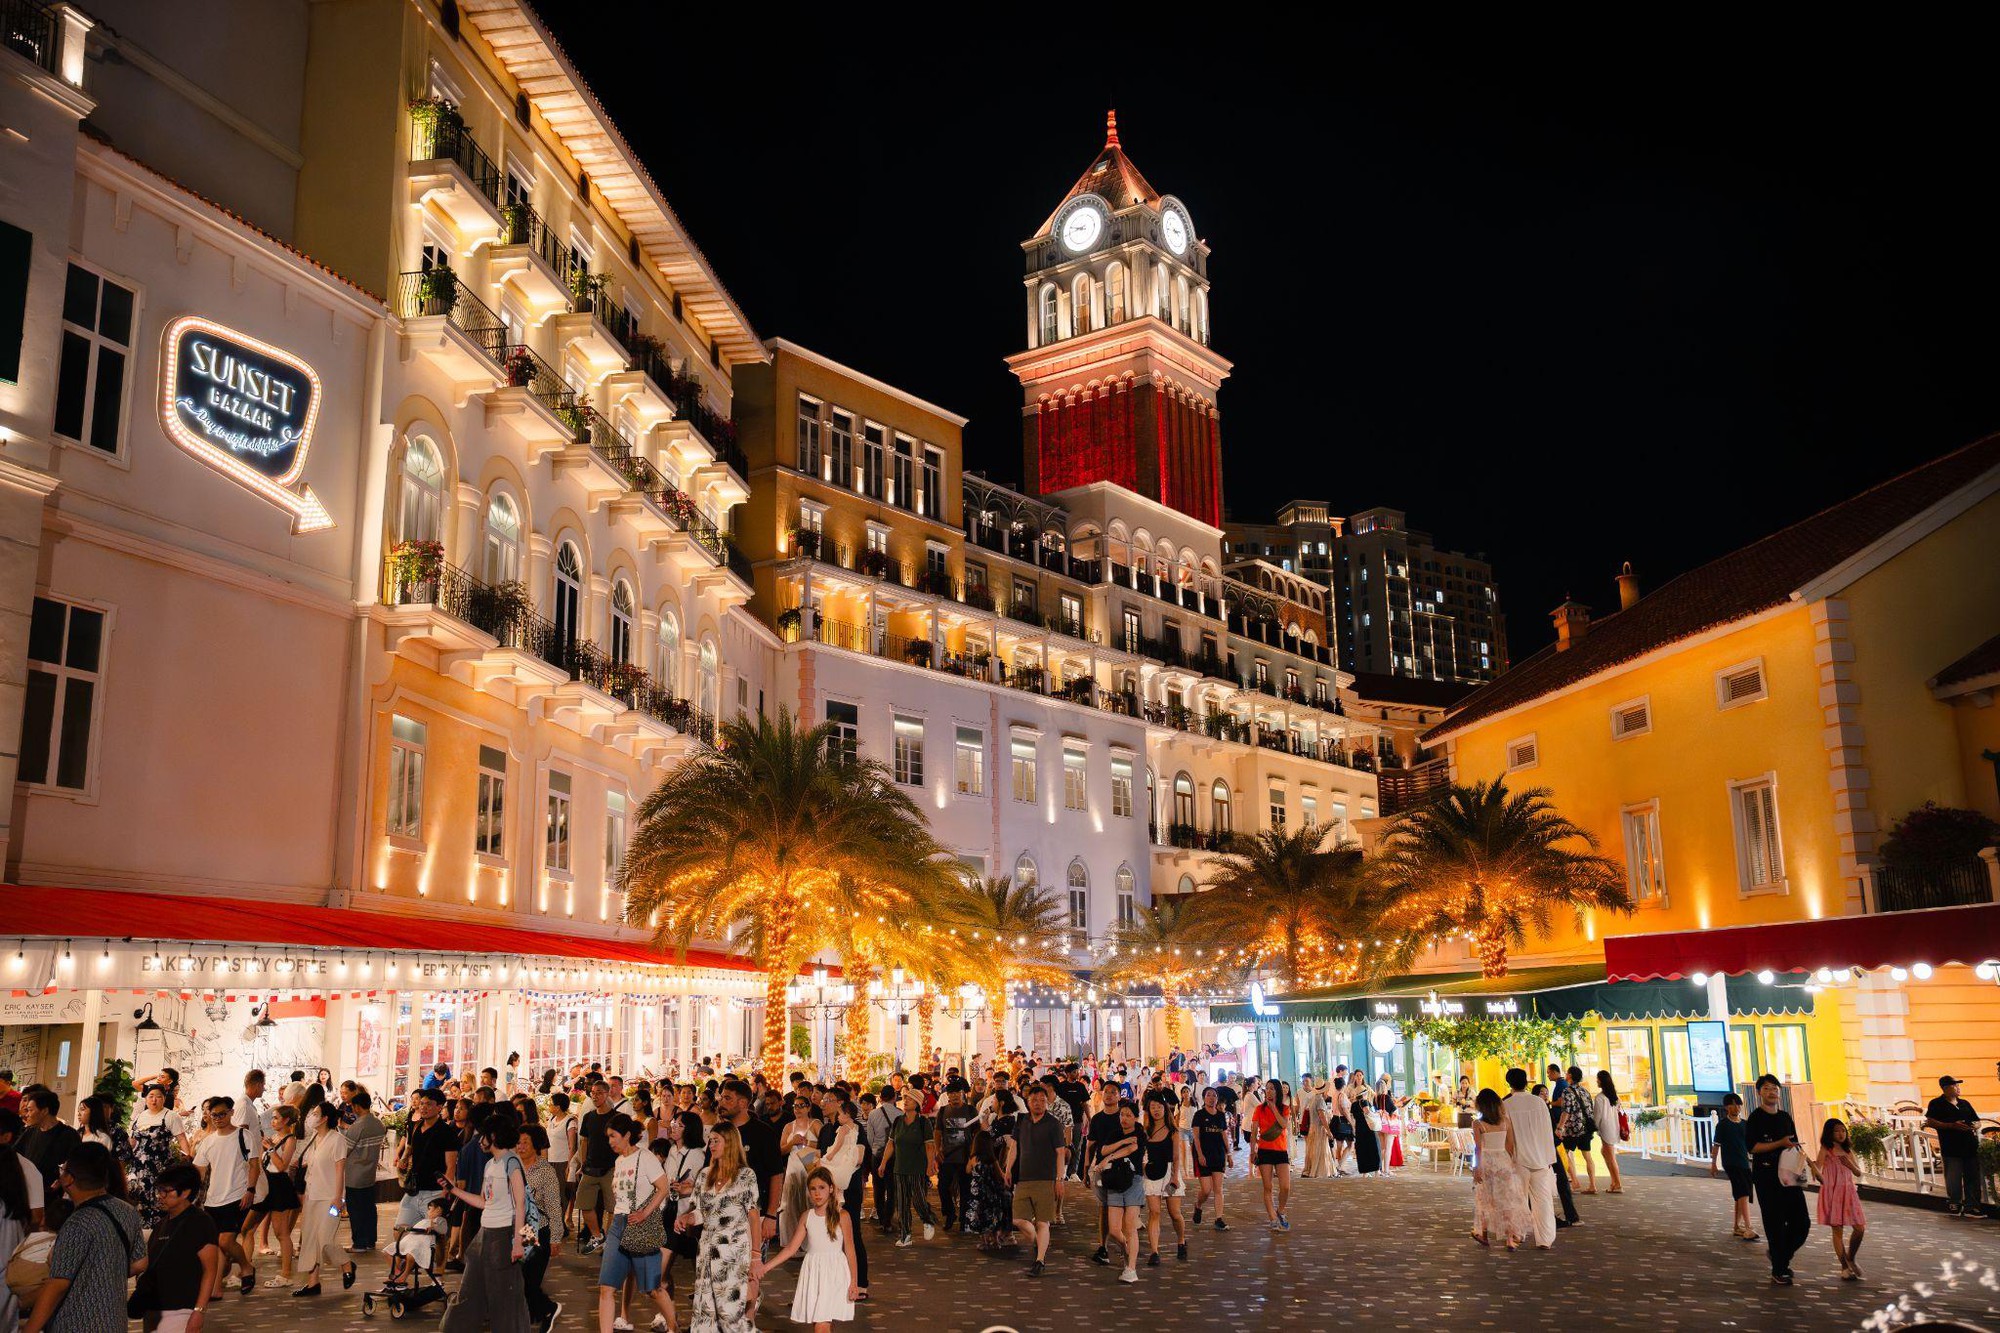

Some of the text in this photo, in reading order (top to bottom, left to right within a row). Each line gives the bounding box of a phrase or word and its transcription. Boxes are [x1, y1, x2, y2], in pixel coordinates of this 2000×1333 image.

[191, 341, 296, 415] SUNSET
[197, 409, 217, 434] Day
[209, 387, 272, 431] BAZAAR
[142, 955, 327, 974] BAKERY PASTRY COFFEE
[4, 1003, 21, 1011] ERIC
